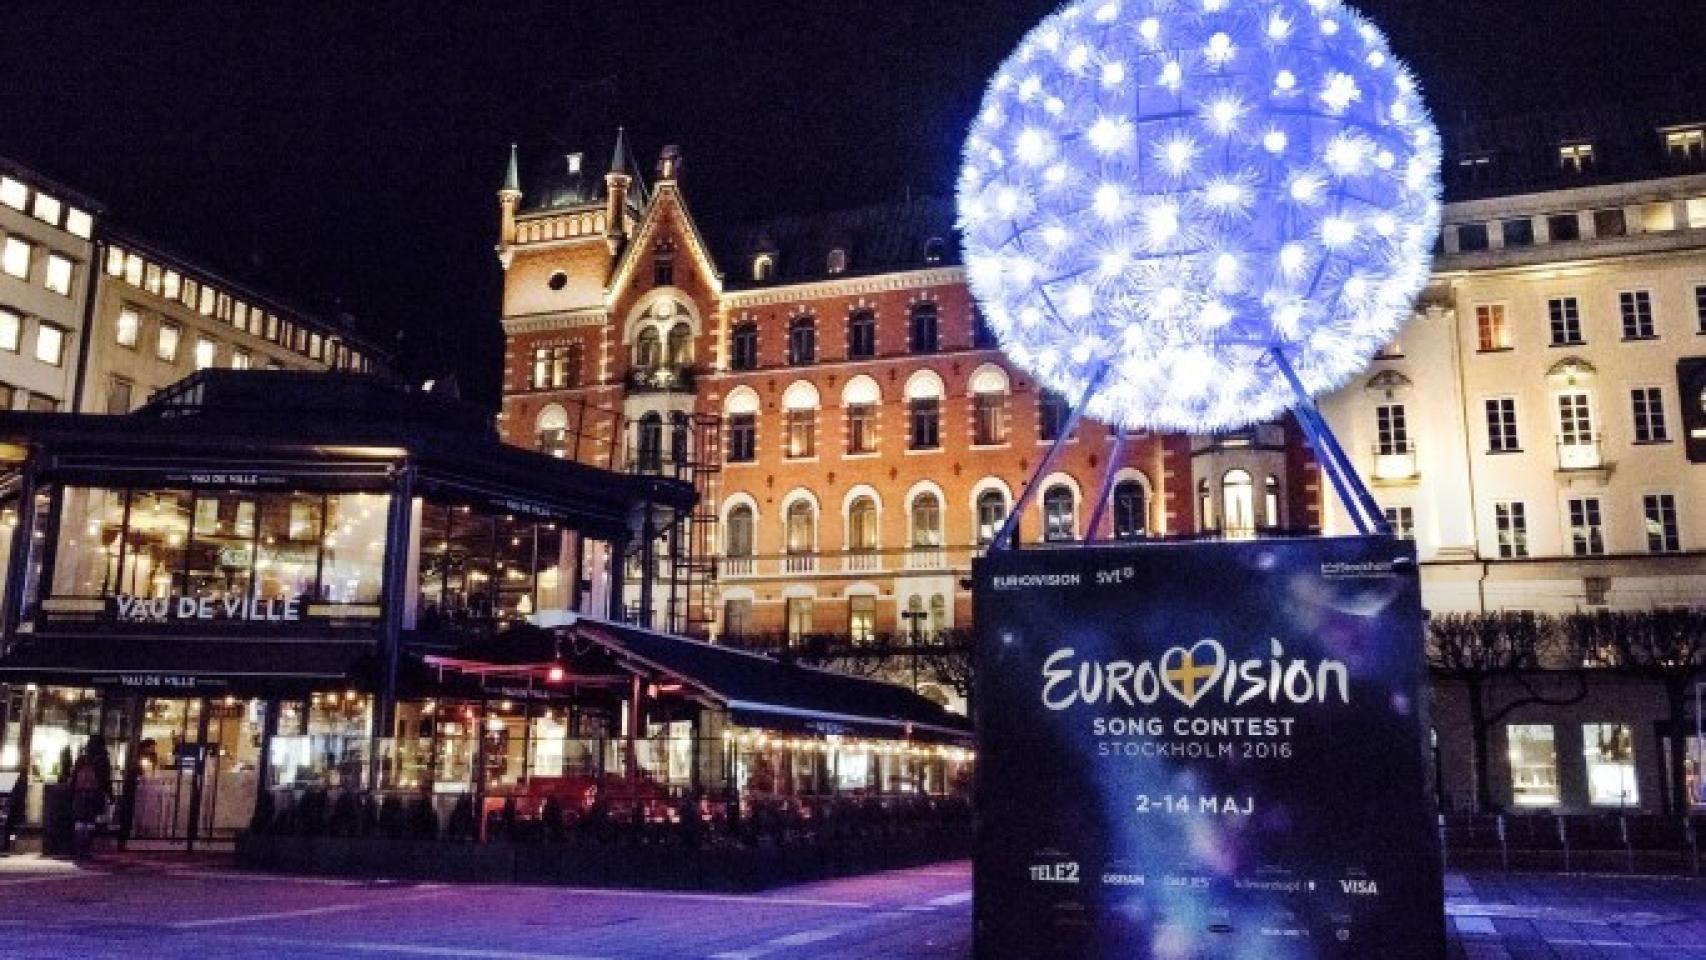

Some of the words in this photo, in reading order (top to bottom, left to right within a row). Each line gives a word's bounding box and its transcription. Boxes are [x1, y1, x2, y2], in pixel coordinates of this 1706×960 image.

[176, 597, 214, 619] DE
[224, 594, 300, 621] VILLE
[1093, 716, 1165, 736] SONG
[1173, 716, 1295, 736] CONTEST
[1097, 742, 1233, 758] STOCKHOLM
[1243, 742, 1293, 758] 2016
[1135, 794, 1190, 813] 2-14
[1199, 796, 1255, 816] MAJ
[1029, 862, 1080, 882] TELE2
[1338, 879, 1379, 895] VISA
